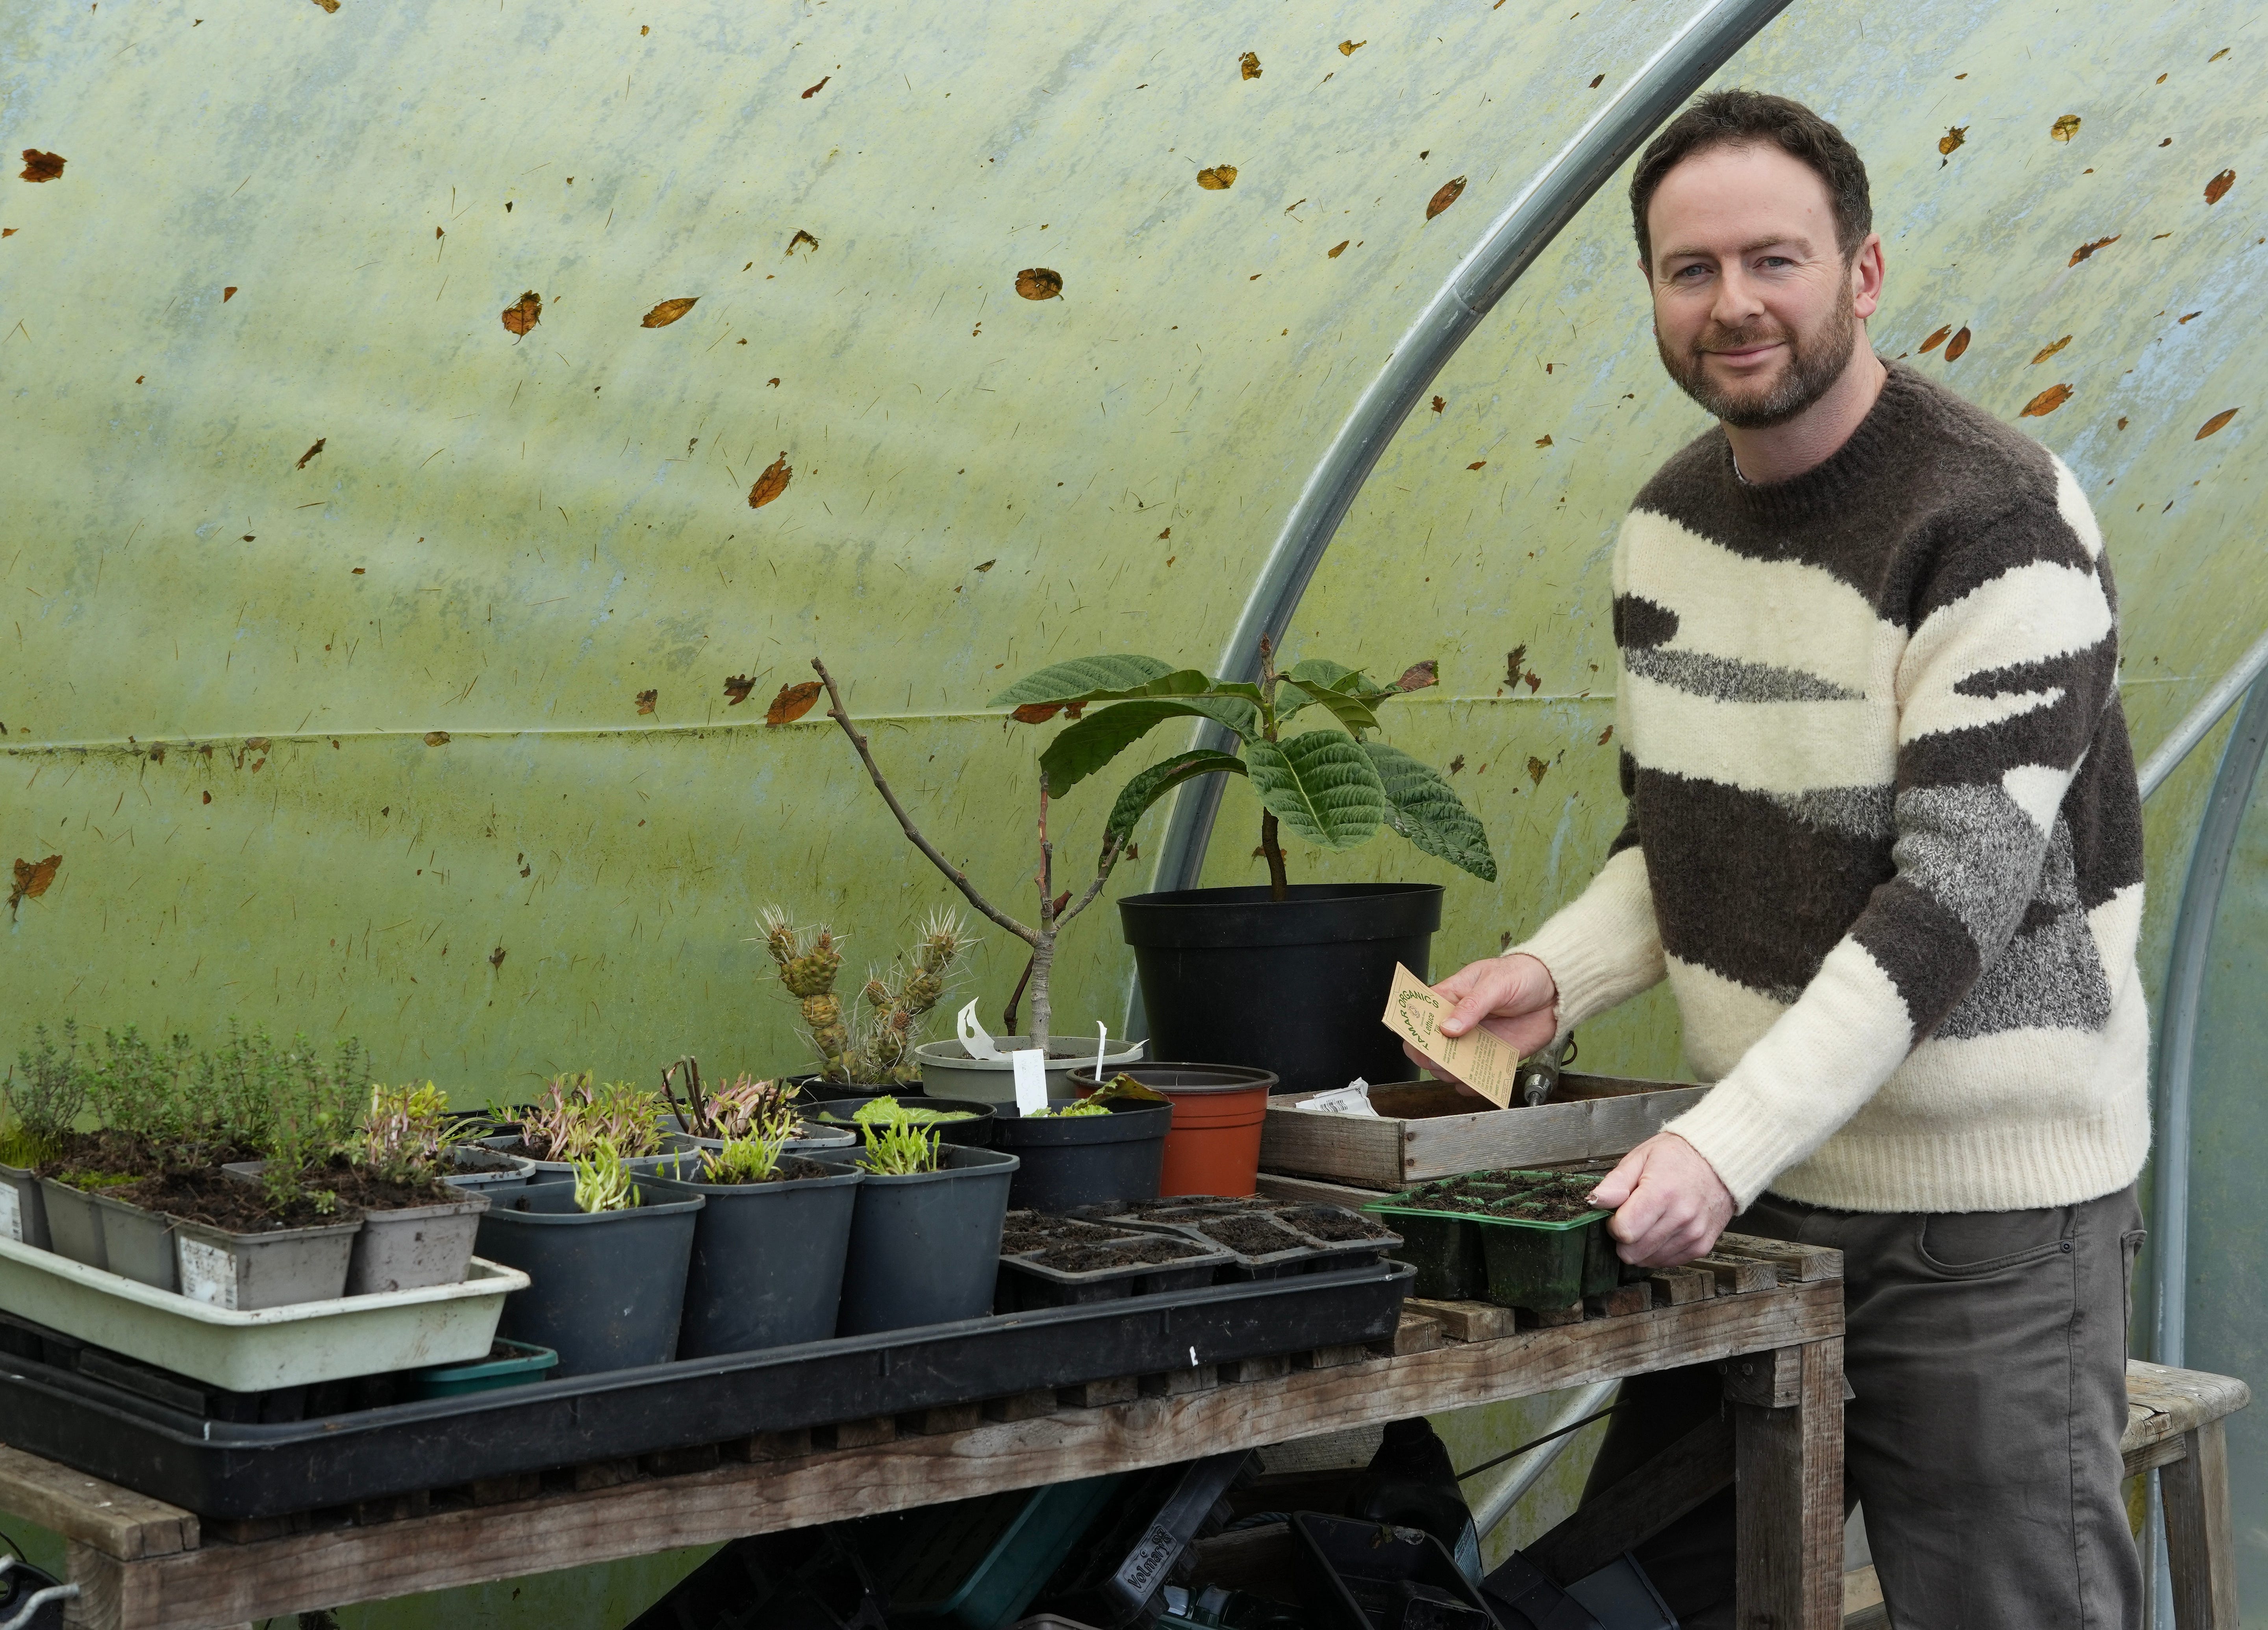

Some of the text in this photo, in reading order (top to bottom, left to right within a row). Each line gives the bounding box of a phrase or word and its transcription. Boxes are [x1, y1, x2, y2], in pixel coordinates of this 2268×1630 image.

[1399, 990, 1439, 1051] TAMAR ORGANICS
[1423, 1012, 1434, 1035] Lettuce
[1128, 1539, 1170, 1588] Volmary
